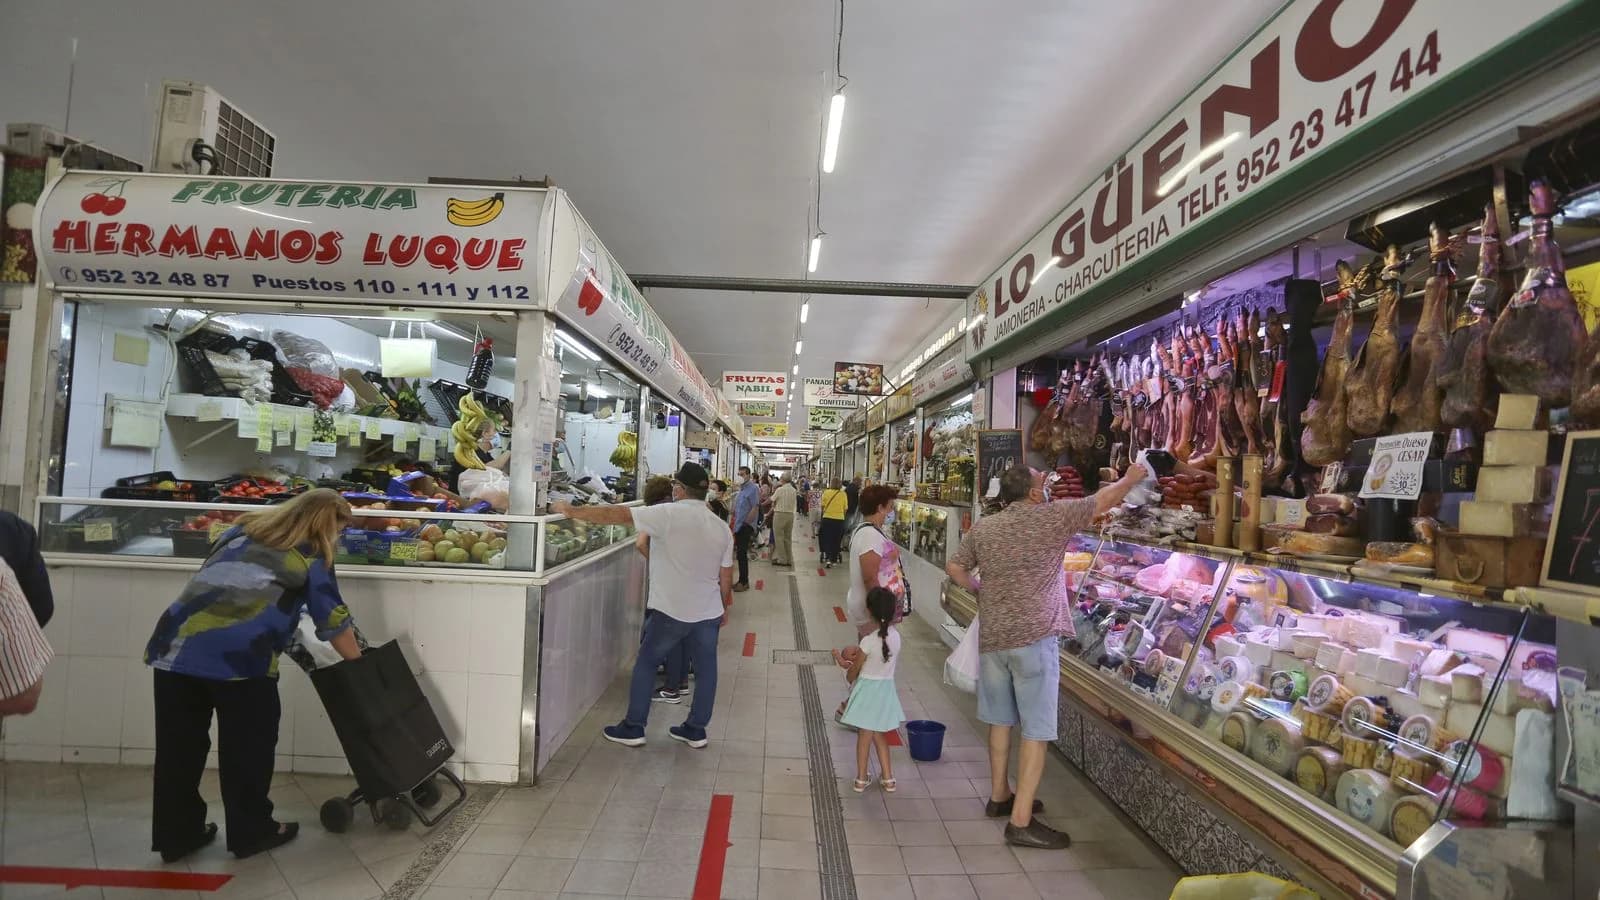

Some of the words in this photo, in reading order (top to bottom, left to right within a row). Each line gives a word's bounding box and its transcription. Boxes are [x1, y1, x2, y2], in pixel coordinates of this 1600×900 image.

[995, 253, 1035, 318] LO
[1052, 0, 1416, 268] GÜENO
[994, 297, 1046, 340] JAMONERIA
[1055, 214, 1170, 303] CHARCUTERIA
[1177, 170, 1229, 228] TELF.
[1237, 137, 1280, 192] 952
[1289, 108, 1324, 162] 23
[1334, 70, 1377, 128] 47
[1389, 29, 1442, 93] 44
[171, 181, 418, 210] FRUTERIA
[53, 220, 344, 265] HERMANOS
[363, 232, 527, 275] LUQUE
[81, 268, 126, 284] 952
[131, 271, 162, 286] 32
[168, 272, 197, 287] 48
[203, 274, 230, 288] 87
[252, 273, 346, 292] Puestos
[353, 279, 395, 295] 110
[417, 282, 457, 298] 111
[467, 287, 479, 300] y
[487, 285, 530, 300] 112
[615, 332, 635, 355] 952
[631, 347, 644, 363] 32
[725, 375, 785, 384] FRUTAS
[805, 378, 833, 386] PANADE
[735, 384, 773, 397] NABIL
[819, 399, 856, 407] CONFITERIA
[1402, 438, 1427, 449] Queso
[1398, 450, 1425, 462] CESAR
